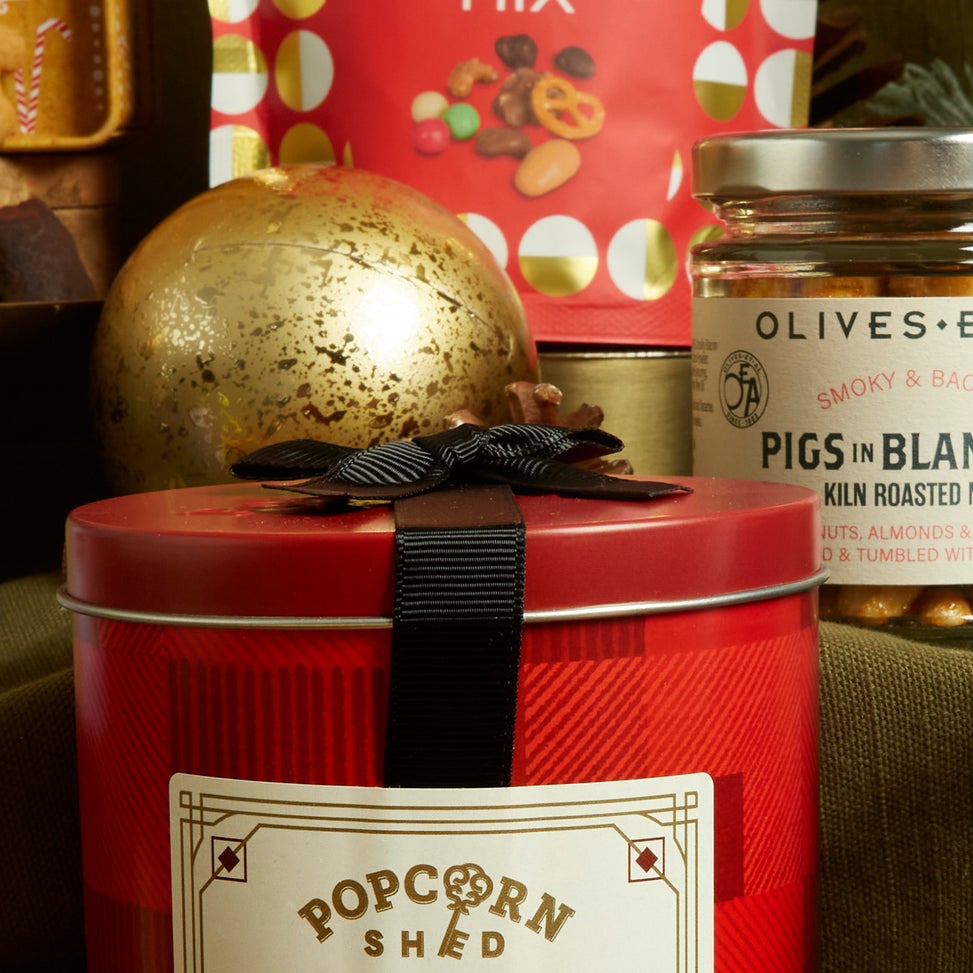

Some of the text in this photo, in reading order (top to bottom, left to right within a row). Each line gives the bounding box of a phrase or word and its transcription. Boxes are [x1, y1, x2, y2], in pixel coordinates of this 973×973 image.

[817, 370, 896, 411] SMOKY
[905, 369, 921, 388] &
[761, 432, 844, 470] PIGS
[852, 443, 874, 463] IN
[824, 482, 867, 507] KILN
[874, 482, 961, 507] ROASTED
[867, 525, 954, 540] ALMONDS
[960, 524, 971, 539] &
[839, 548, 850, 562] &
[857, 548, 938, 563] TUMBLED
[364, 929, 506, 960] SHED
